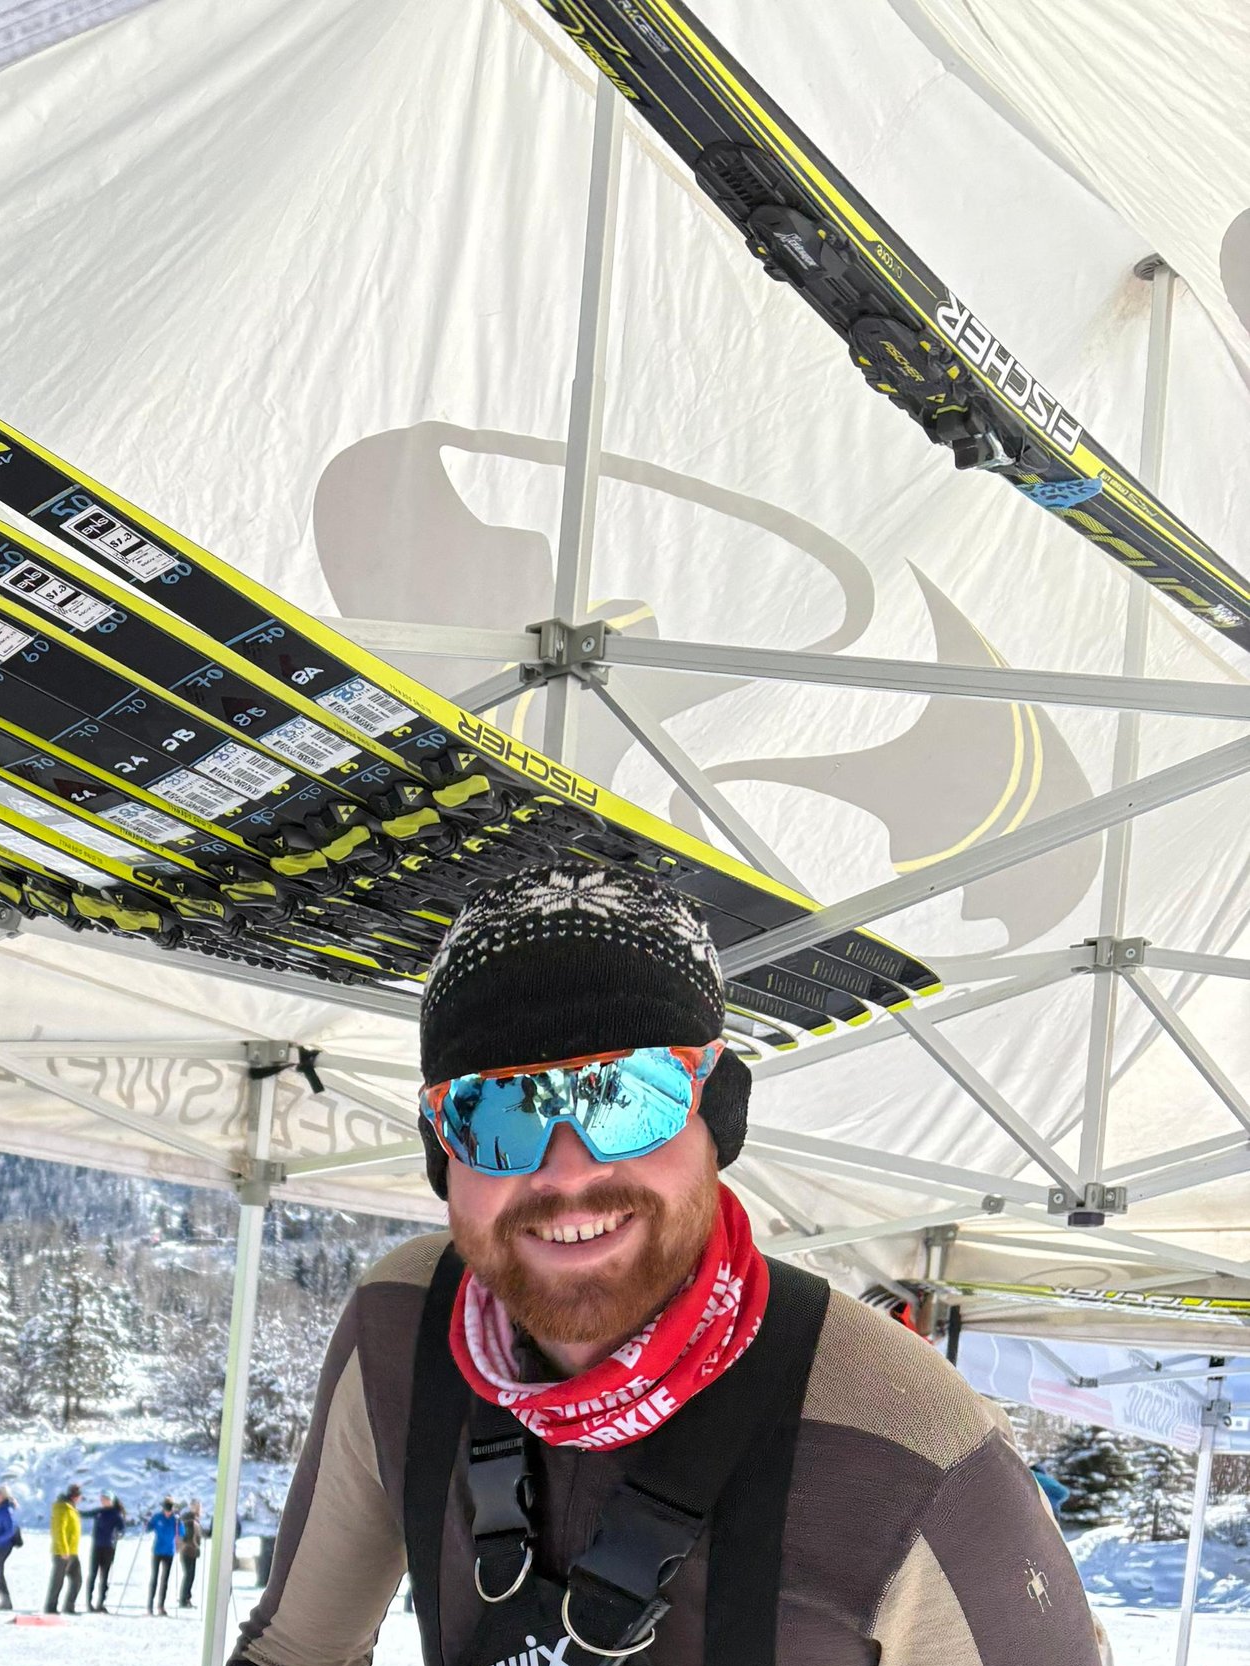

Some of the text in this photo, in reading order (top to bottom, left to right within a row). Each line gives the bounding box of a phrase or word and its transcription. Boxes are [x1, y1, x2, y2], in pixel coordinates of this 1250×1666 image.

[879, 340, 925, 383] FISCHER
[936, 286, 1083, 452] FISCHER
[51, 494, 93, 517] 50
[160, 562, 192, 585] 60
[95, 610, 128, 633] 60
[21, 640, 50, 663] 60
[290, 666, 324, 686] 8A
[161, 728, 196, 751] 2B
[416, 733, 447, 750] 90
[458, 710, 599, 807] FISCHER
[361, 766, 392, 784] 90
[299, 786, 322, 801] 90
[250, 809, 275, 825] 90
